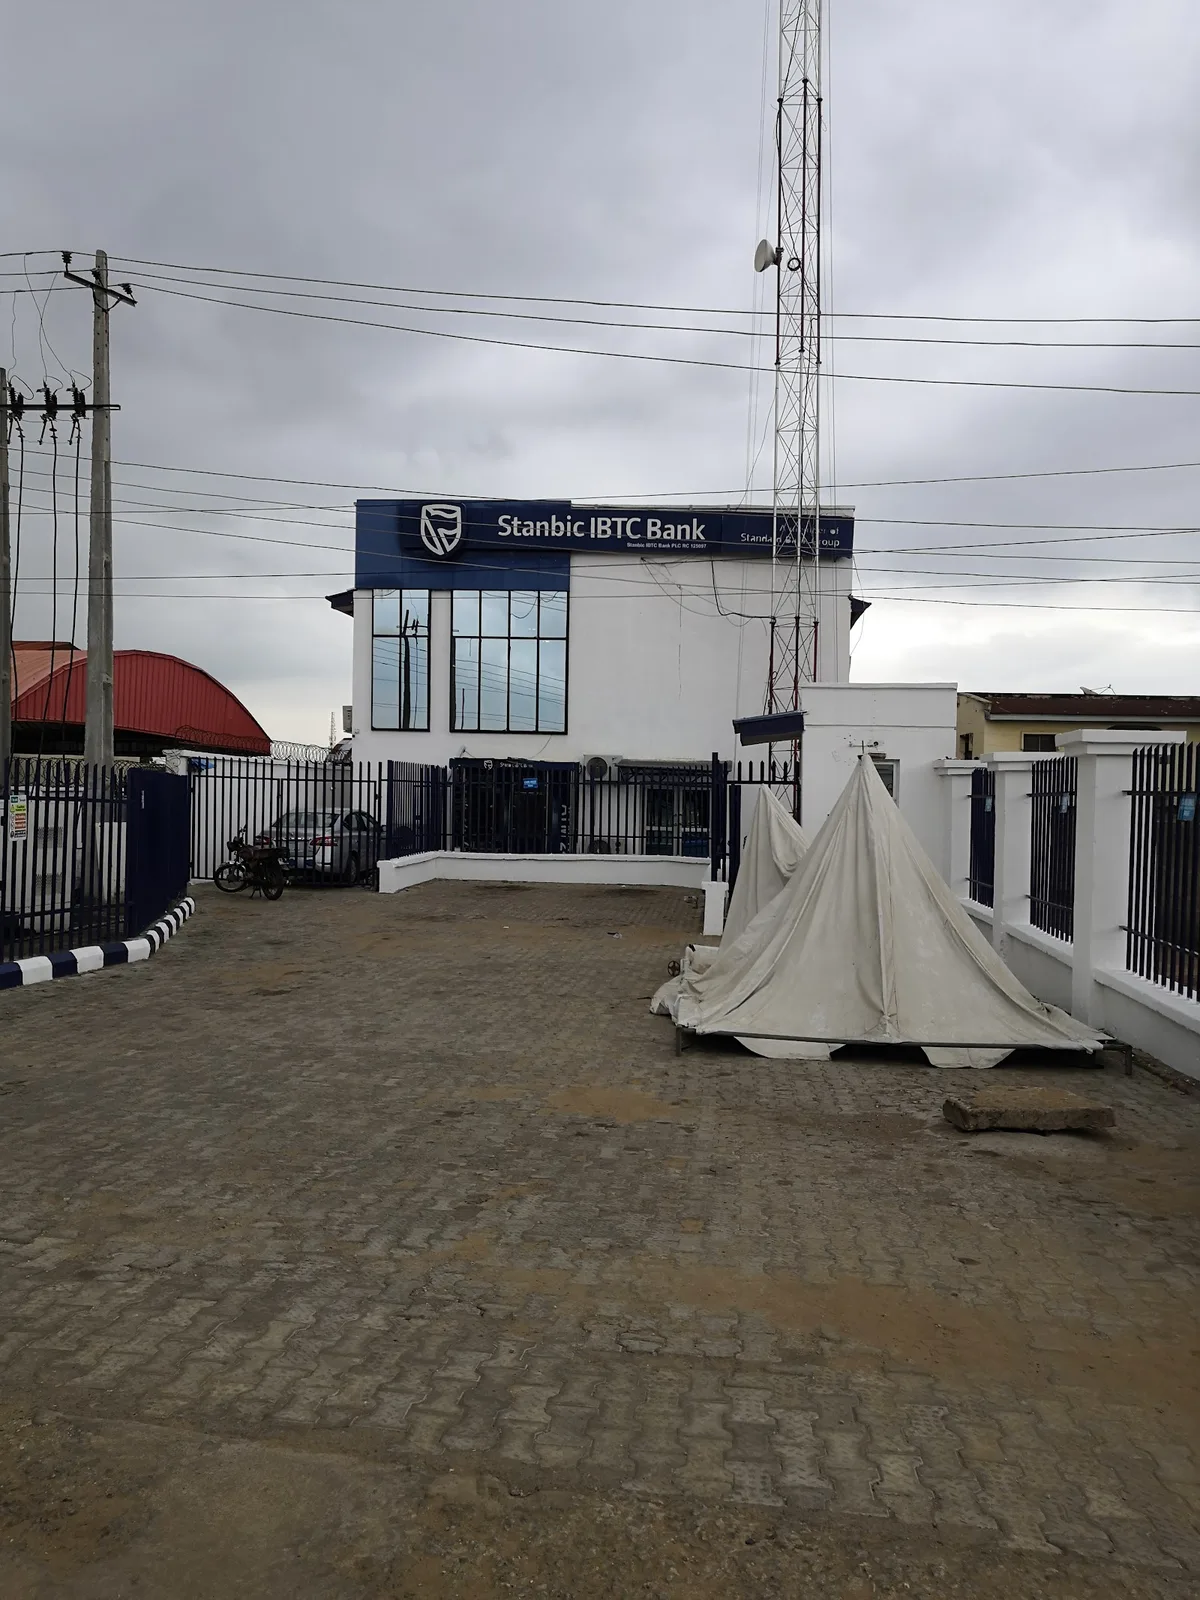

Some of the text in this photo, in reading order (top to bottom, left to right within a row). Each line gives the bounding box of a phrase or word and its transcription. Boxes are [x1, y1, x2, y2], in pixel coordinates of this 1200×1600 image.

[498, 514, 706, 540] Stanbic IBTC Bank
